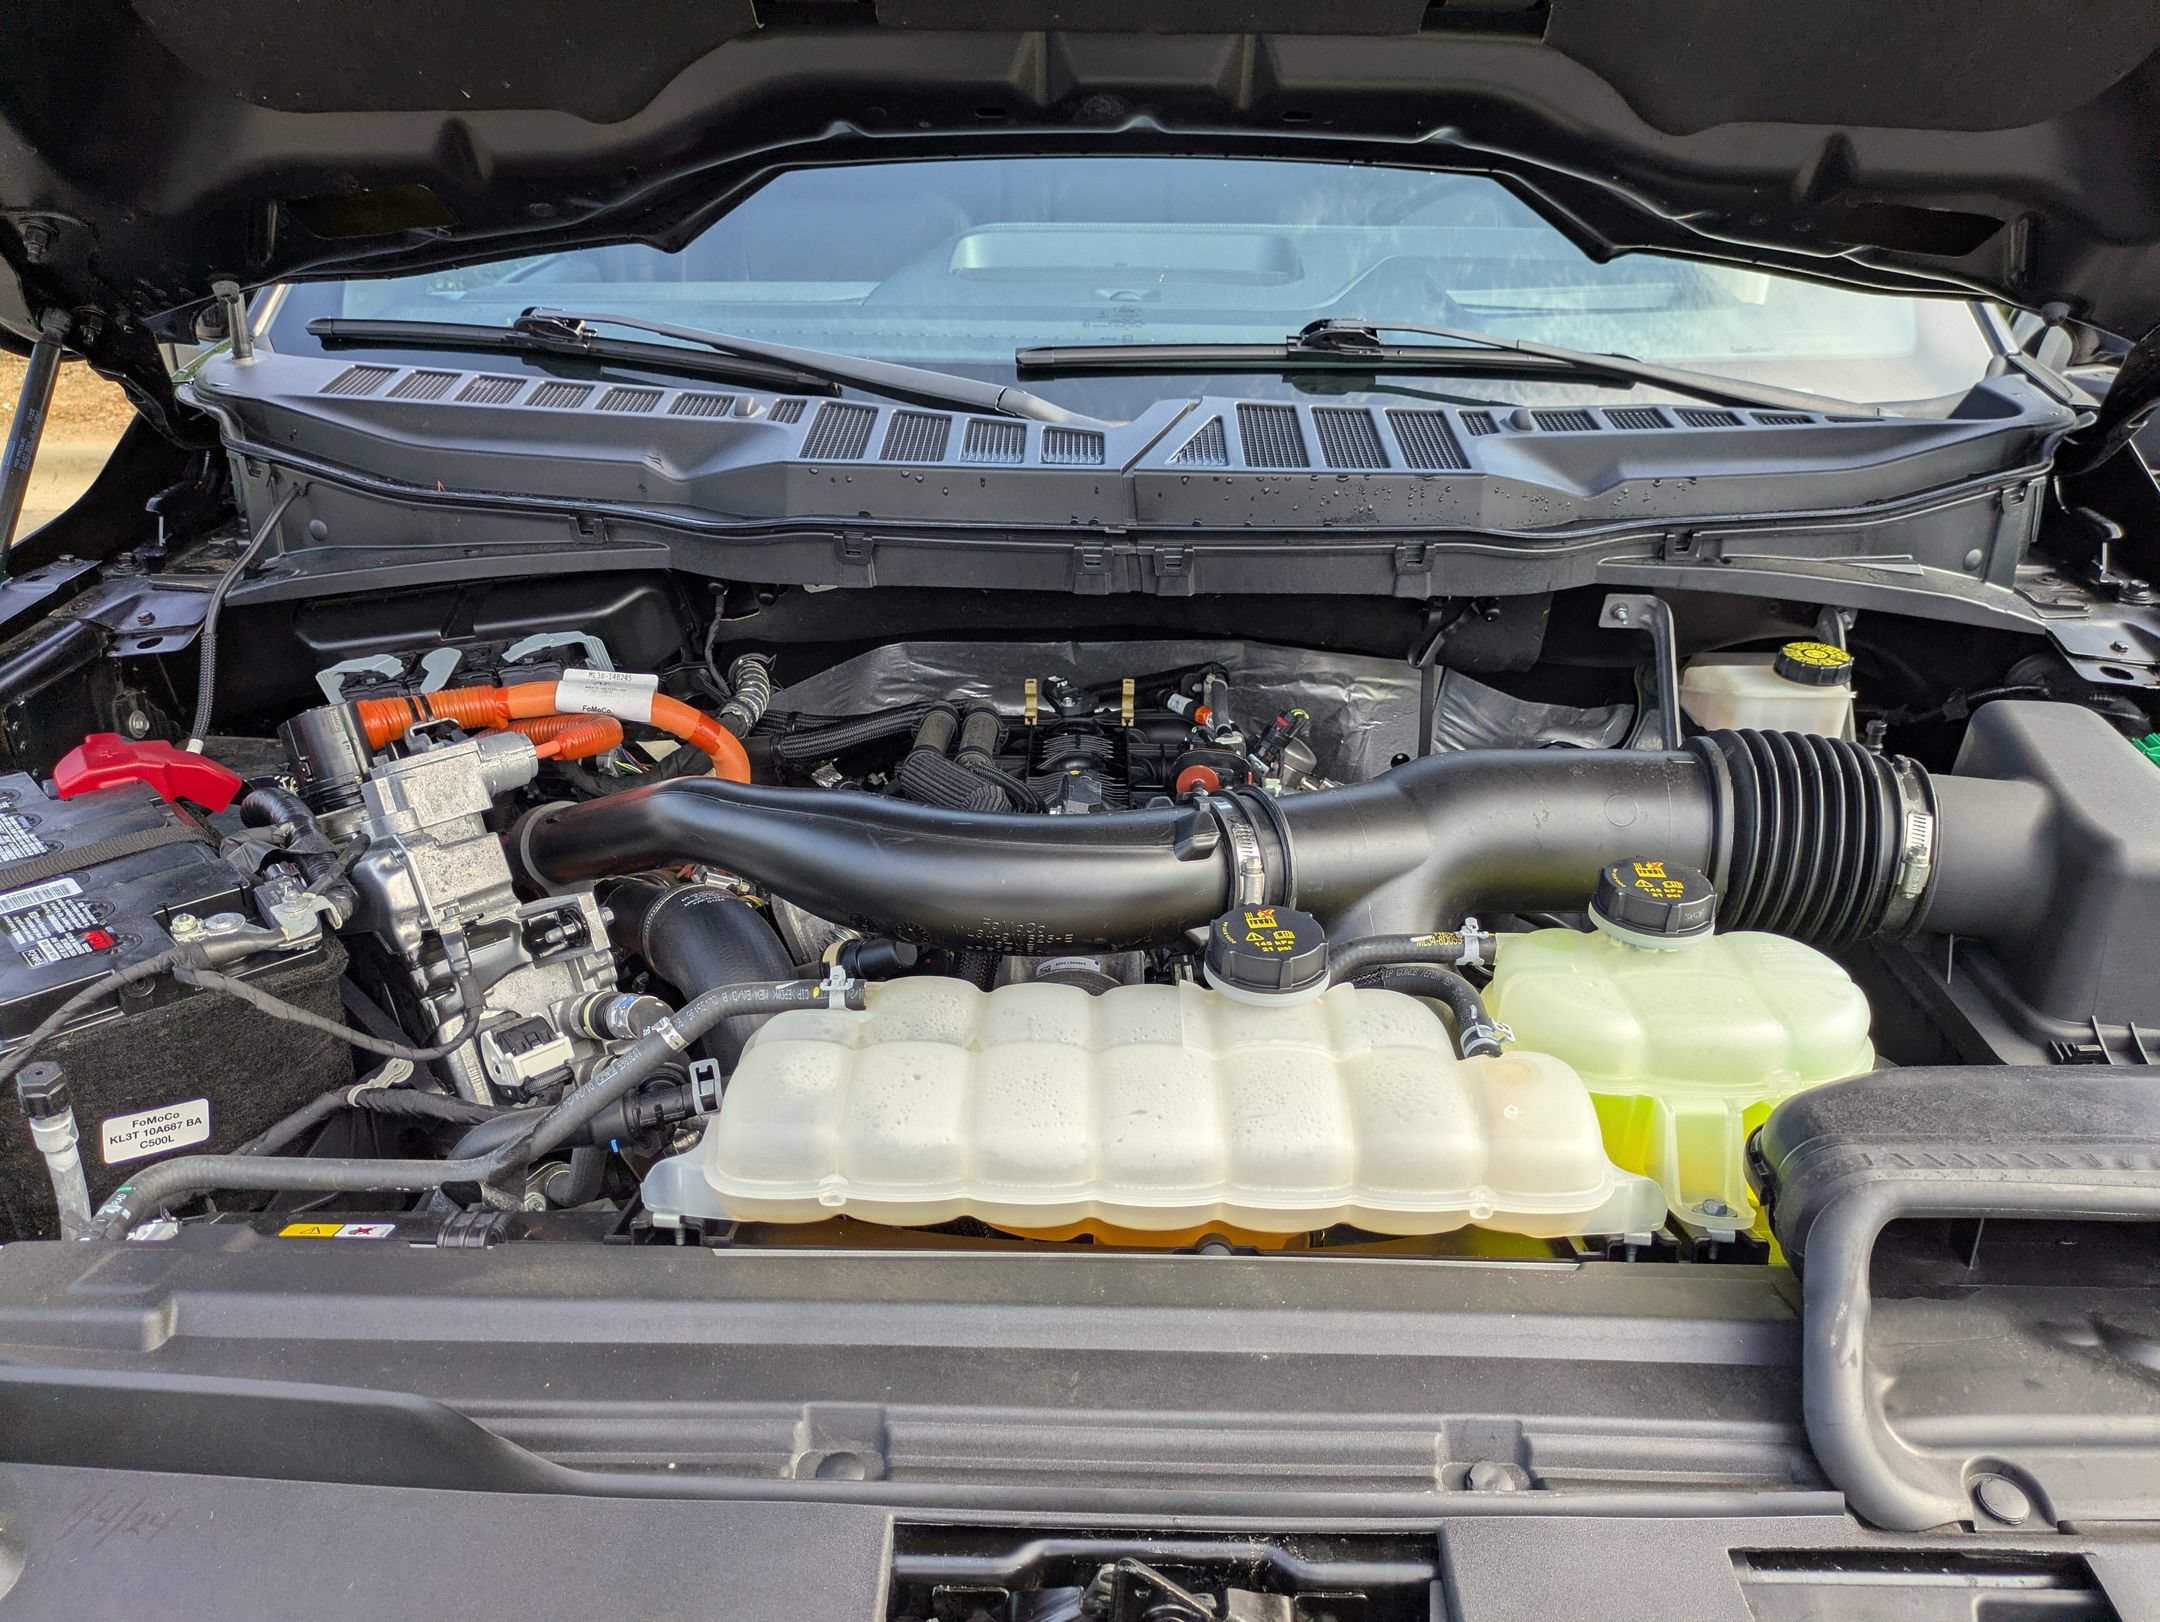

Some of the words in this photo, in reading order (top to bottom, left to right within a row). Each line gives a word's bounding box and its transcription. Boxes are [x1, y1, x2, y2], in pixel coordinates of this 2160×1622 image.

[582, 704, 612, 714] FoMoCo
[132, 1112, 180, 1128] FoMoCo
[110, 1130, 140, 1145] KL3T
[143, 1121, 183, 1137] 10A687
[186, 1117, 203, 1127] BA
[139, 1135, 175, 1149] C500L
